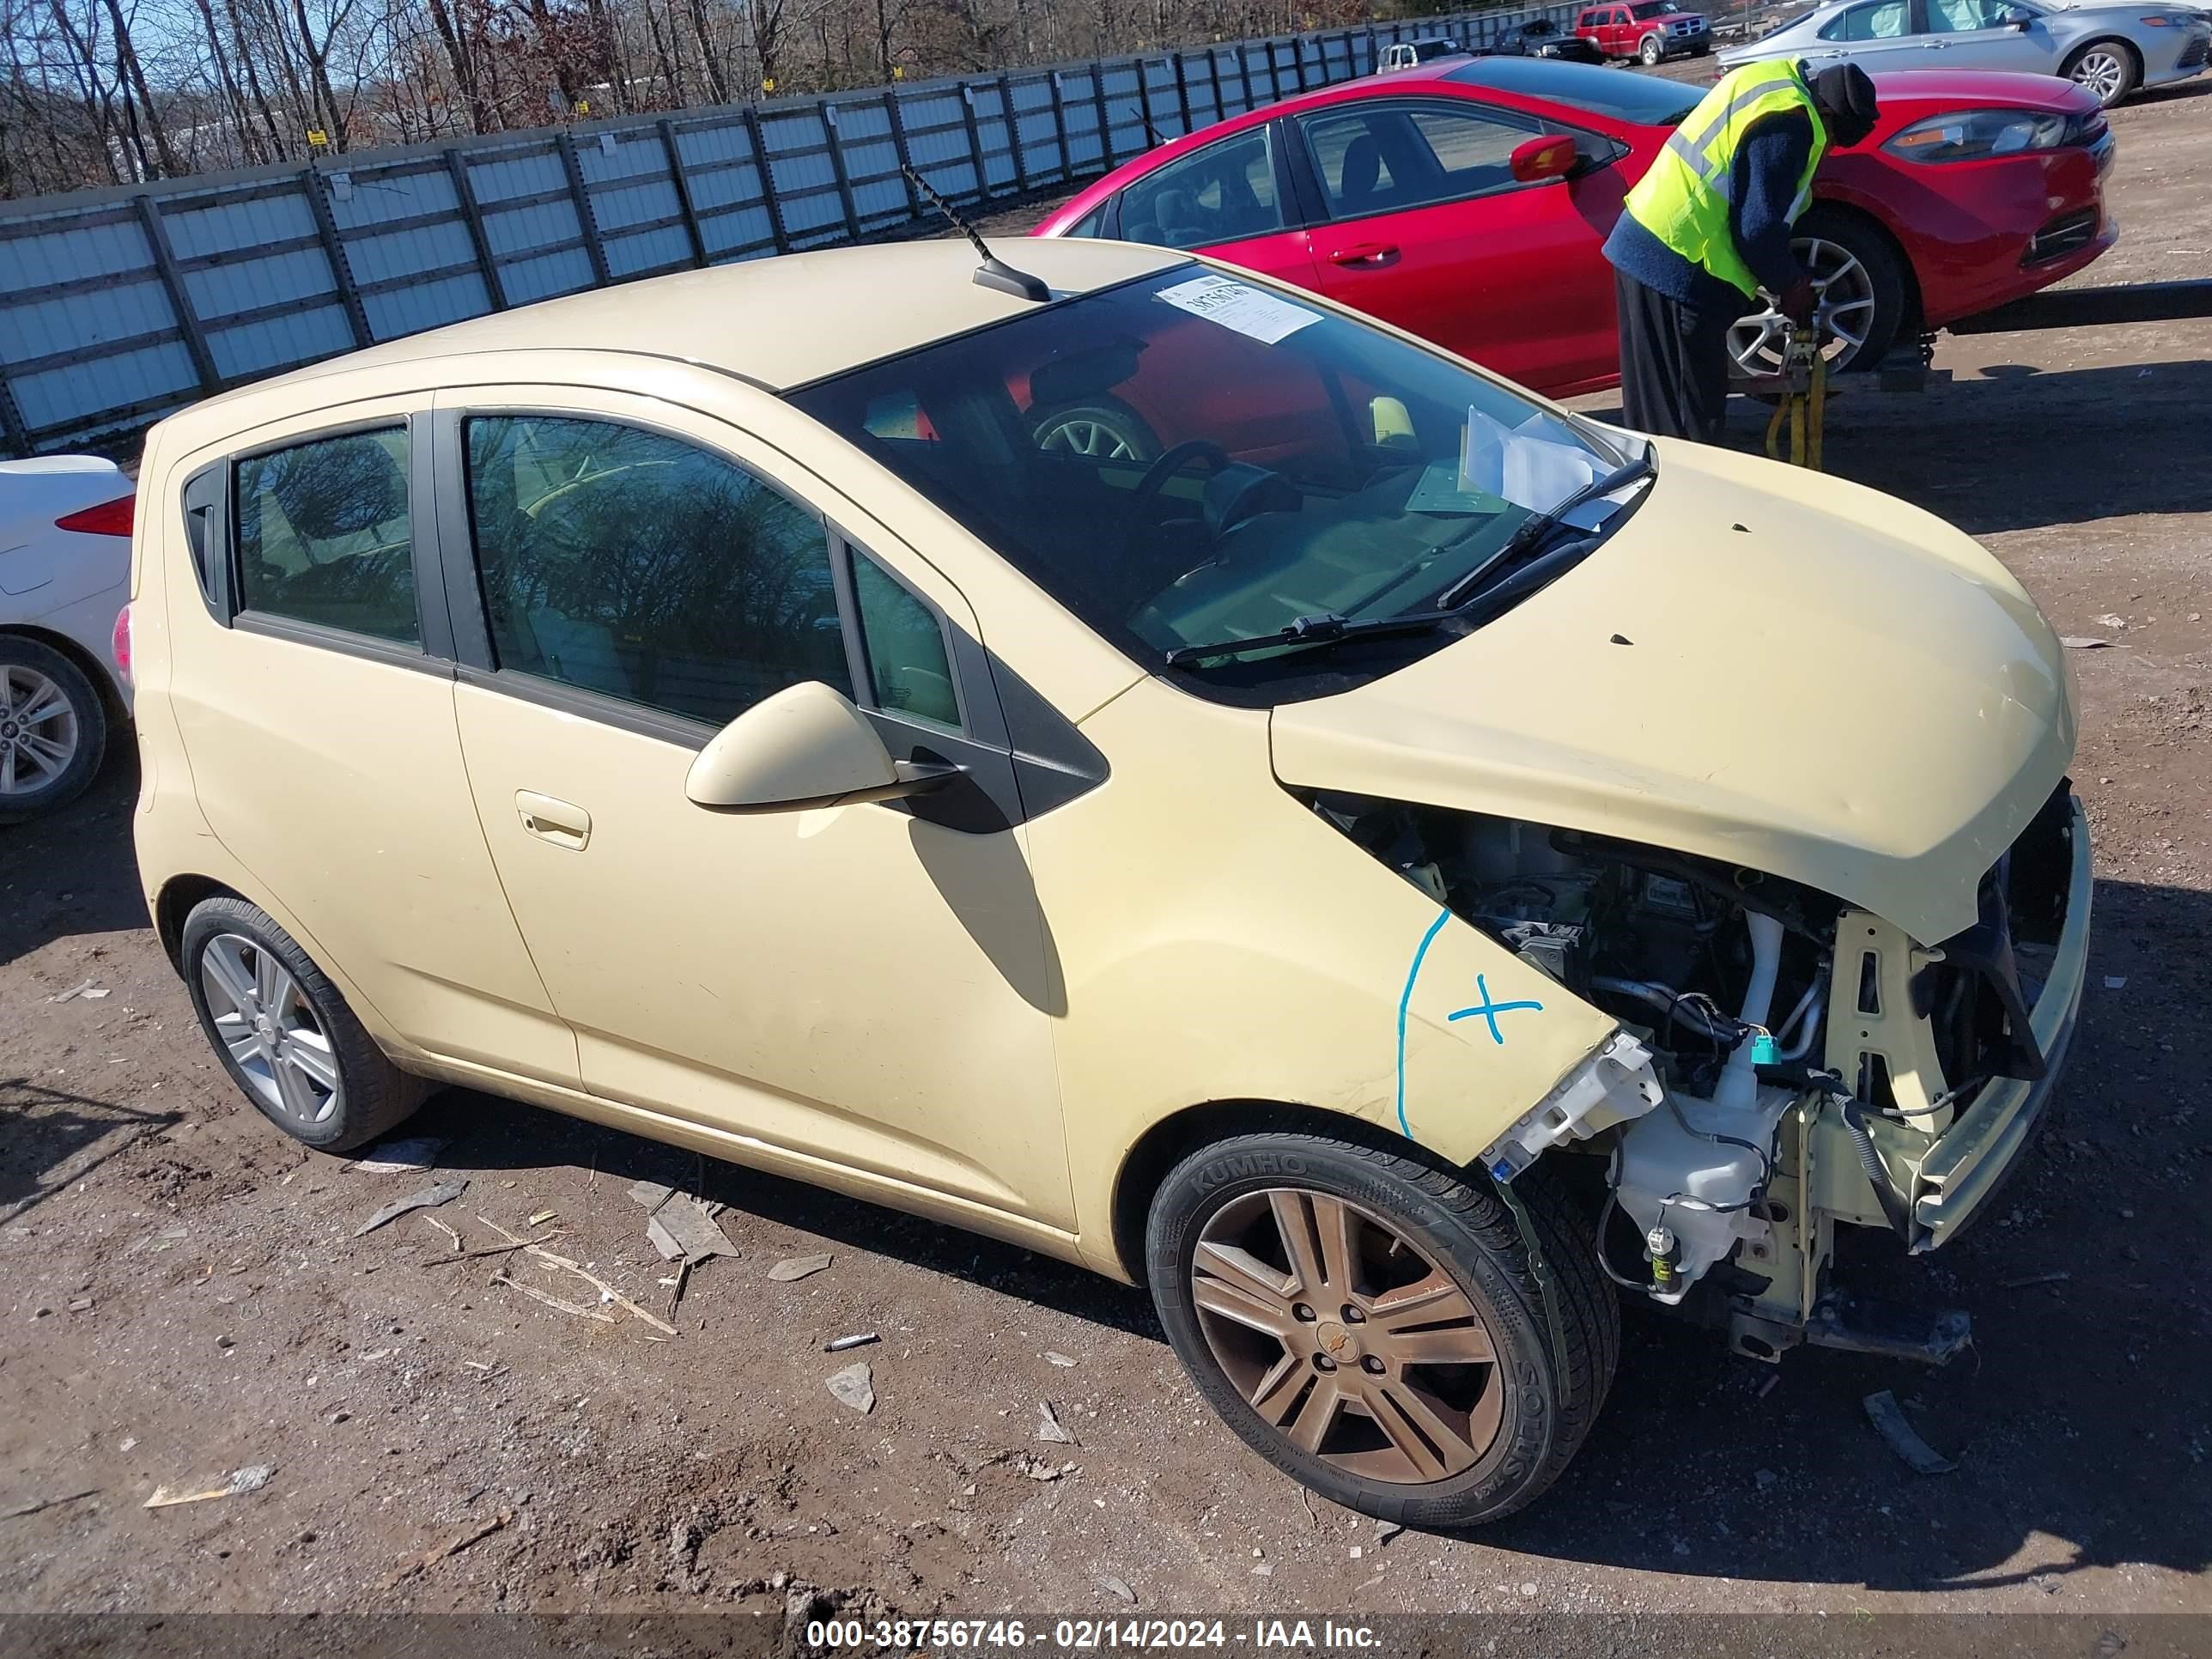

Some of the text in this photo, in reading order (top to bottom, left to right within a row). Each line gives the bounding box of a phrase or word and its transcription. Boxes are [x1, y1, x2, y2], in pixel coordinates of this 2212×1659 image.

[1186, 285, 1249, 311] 38756746
[1190, 1153, 1308, 1196] KUMHO
[1503, 1359, 1546, 1480] SOLUS
